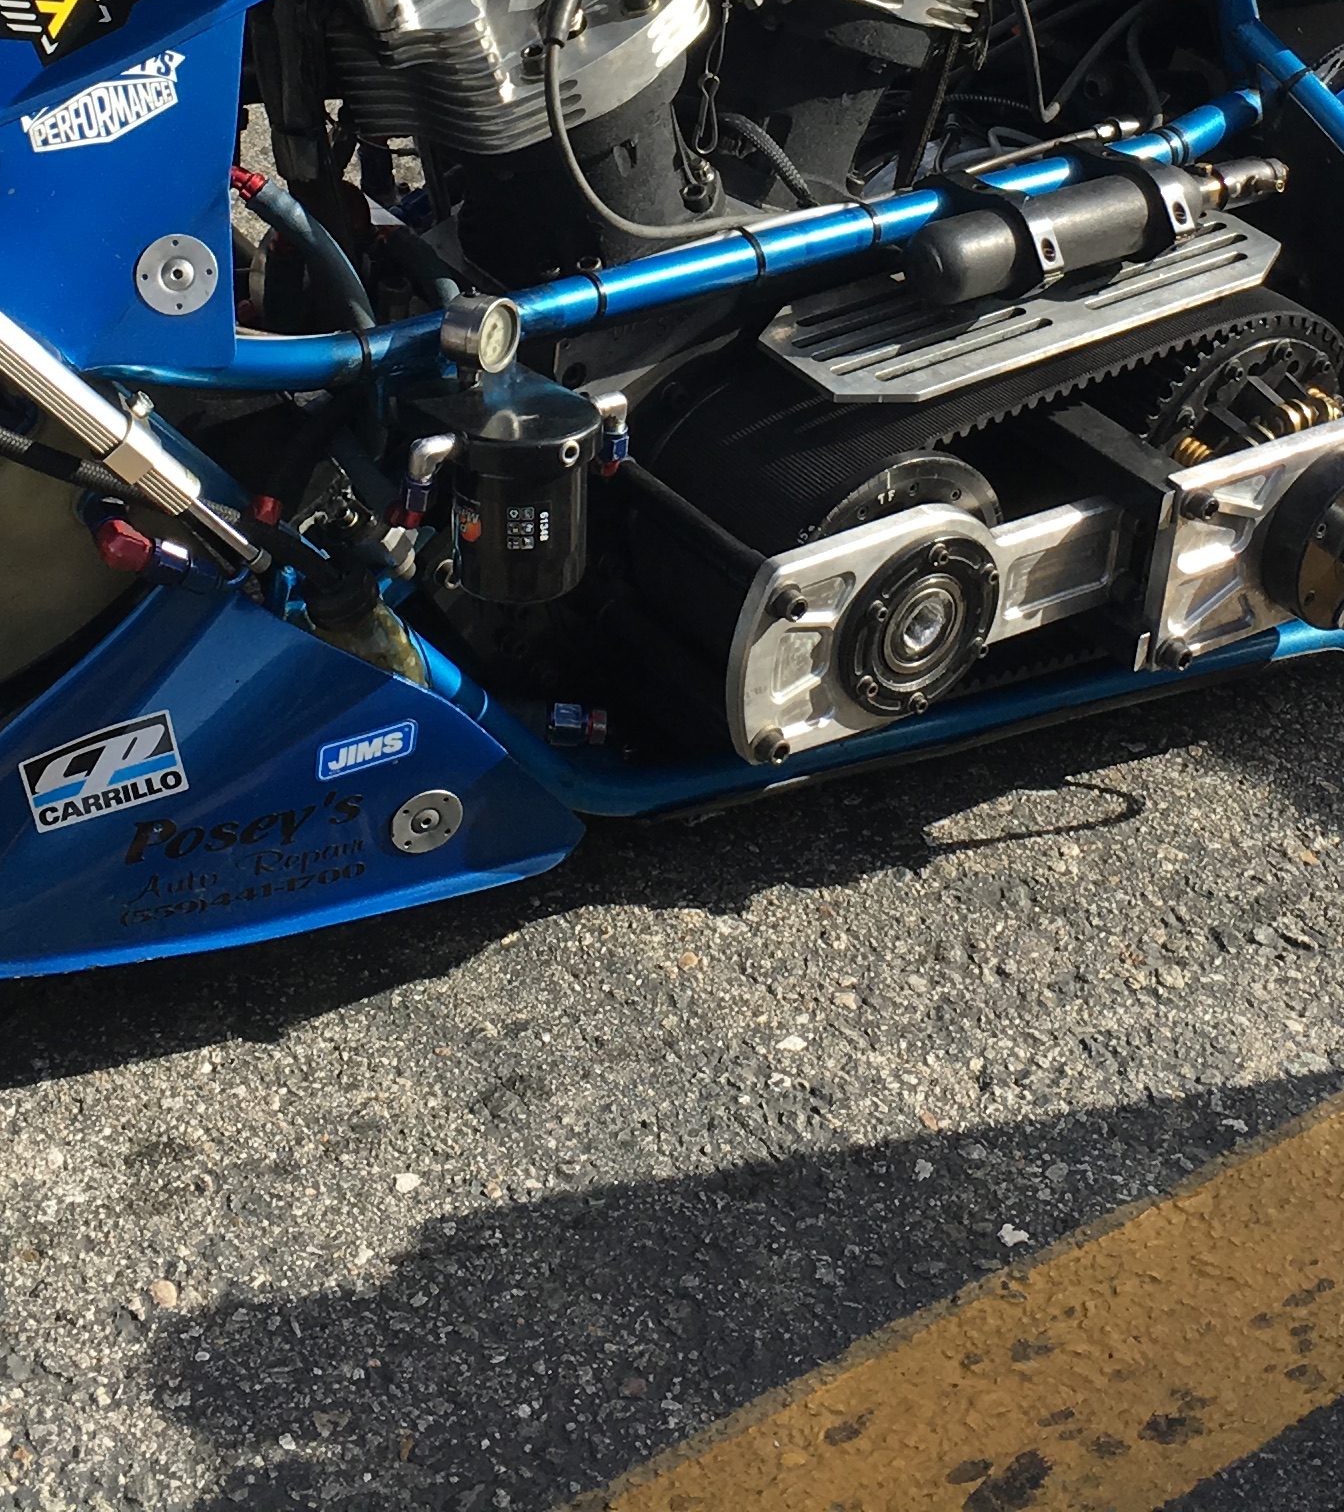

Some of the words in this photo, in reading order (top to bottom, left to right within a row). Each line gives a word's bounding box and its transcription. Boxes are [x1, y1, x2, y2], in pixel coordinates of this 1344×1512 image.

[34, 78, 173, 148] PERFORMANCE
[327, 730, 404, 771] JIMS
[38, 770, 183, 827] CARRILLO
